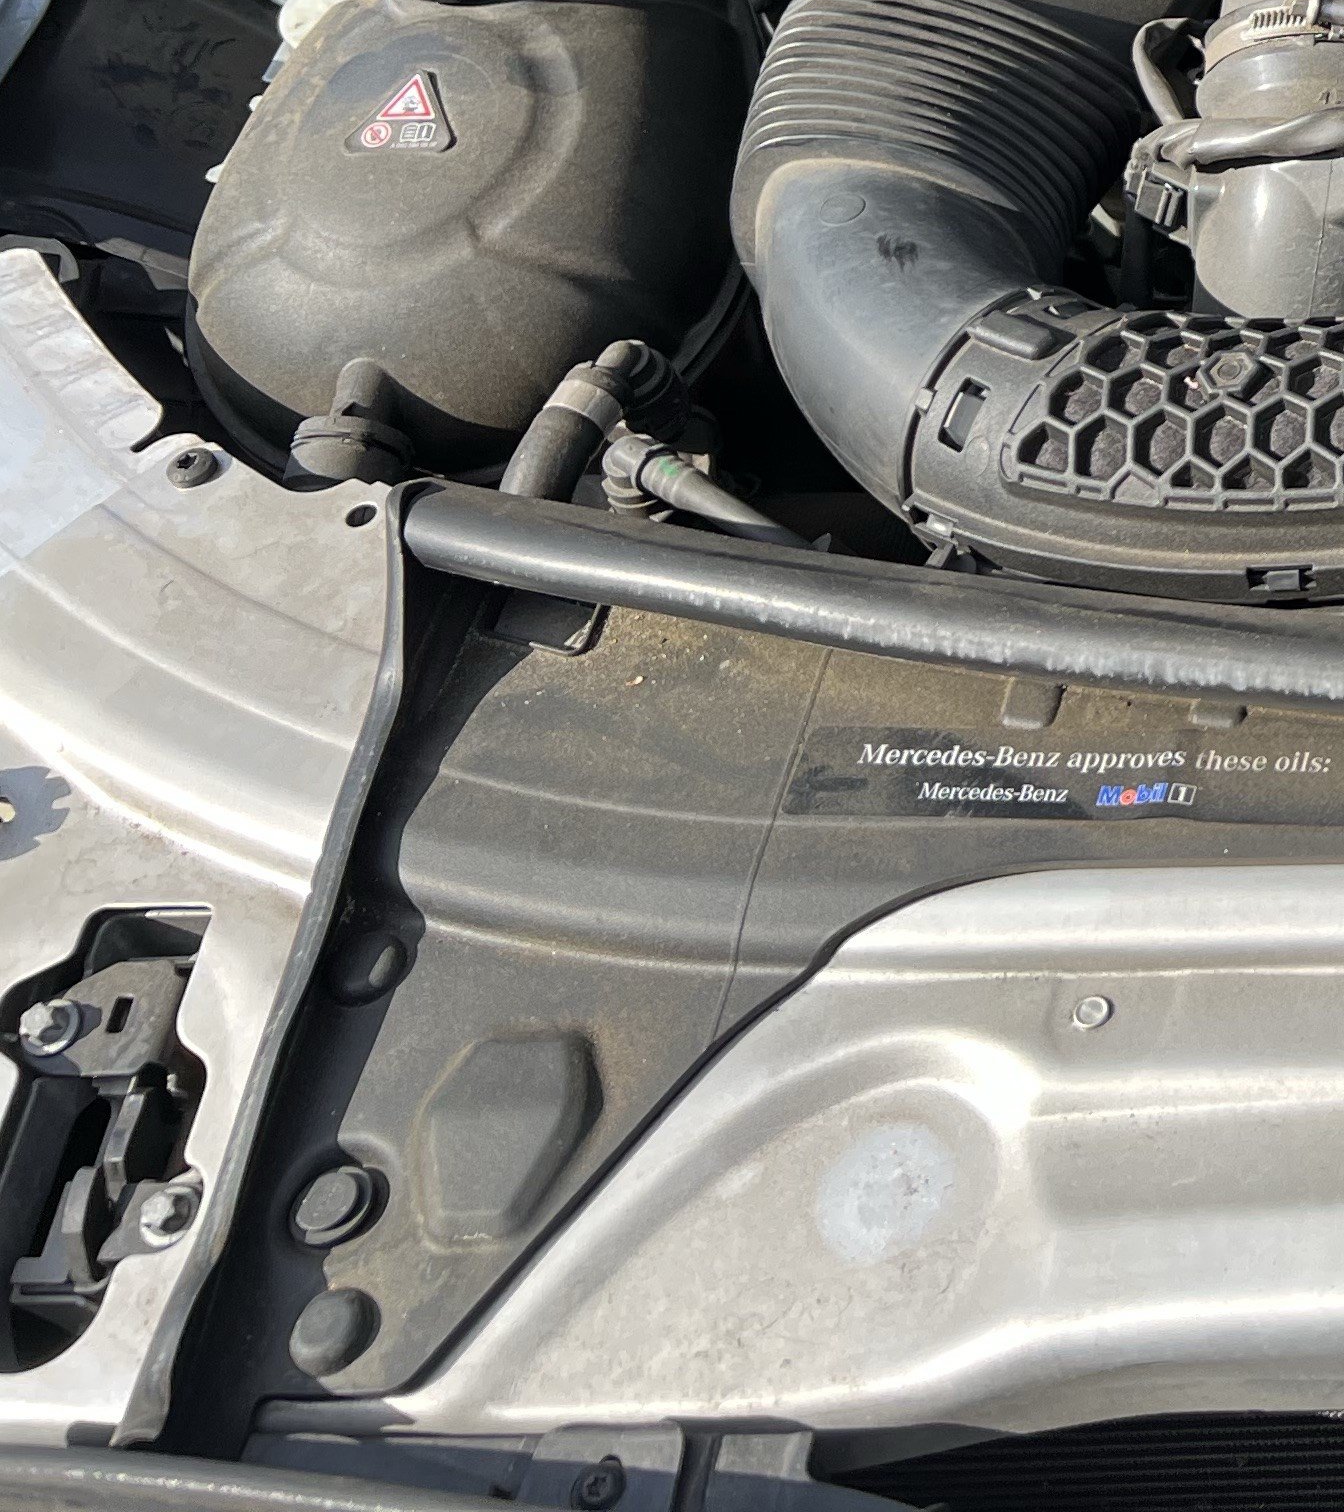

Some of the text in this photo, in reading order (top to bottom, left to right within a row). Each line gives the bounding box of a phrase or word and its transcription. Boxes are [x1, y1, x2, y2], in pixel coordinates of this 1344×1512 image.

[857, 743, 1332, 774] Mercedes-Benz approves these oils:
[917, 781, 1069, 804] Mercedes-Benz
[1096, 781, 1169, 807] Mobil
